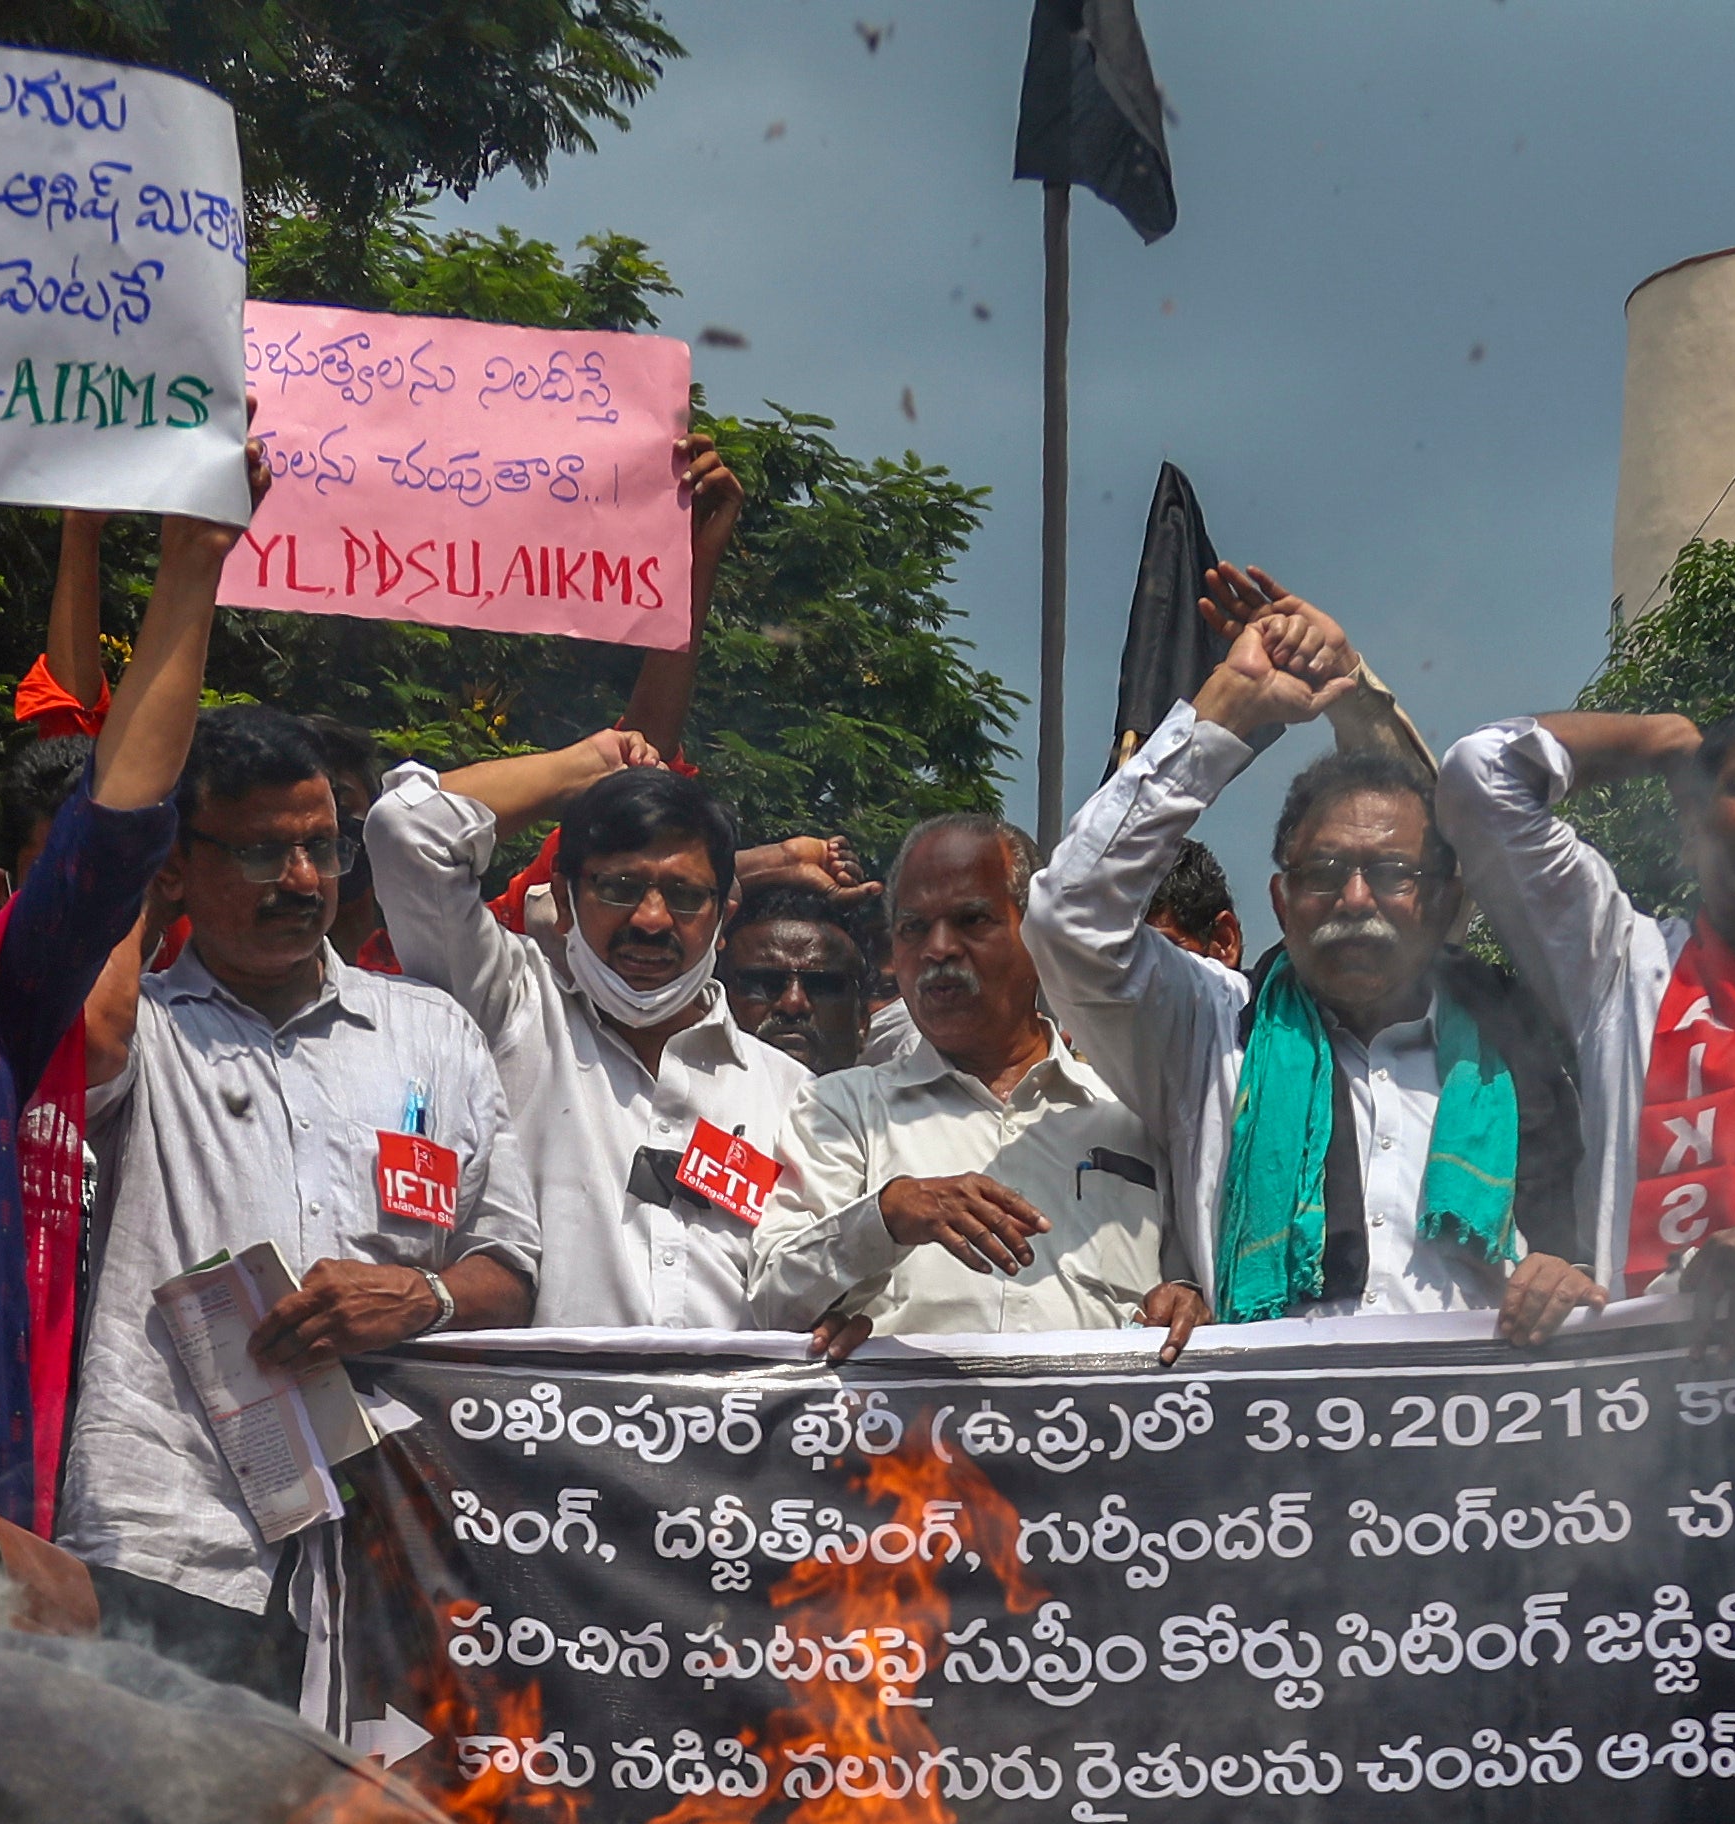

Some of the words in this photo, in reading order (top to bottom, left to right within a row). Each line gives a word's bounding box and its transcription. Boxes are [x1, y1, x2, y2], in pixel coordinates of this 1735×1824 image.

[479, 350, 619, 424] నిలదీస్తే
[384, 1168, 457, 1215] IFTU
[683, 1170, 737, 1210] Telangana
[686, 1146, 771, 1214] IFTU
[791, 1391, 905, 1470] ఖేరీ
[452, 1488, 618, 1563] సింగ్,
[447, 1605, 670, 1680] పరిచిన
[682, 1618, 934, 1708] ఘటనపై
[942, 1601, 1146, 1707] సుప్రీం
[1159, 1603, 1325, 1709] కోర్టు
[1337, 1592, 1569, 1678] సిటింగ్
[457, 1732, 595, 1788] కారు
[611, 1729, 767, 1799] నడిపి
[783, 1744, 1063, 1802] నలుగురు
[1071, 1739, 1343, 1823] రైతులను
[1356, 1727, 1584, 1793] చంపిన
